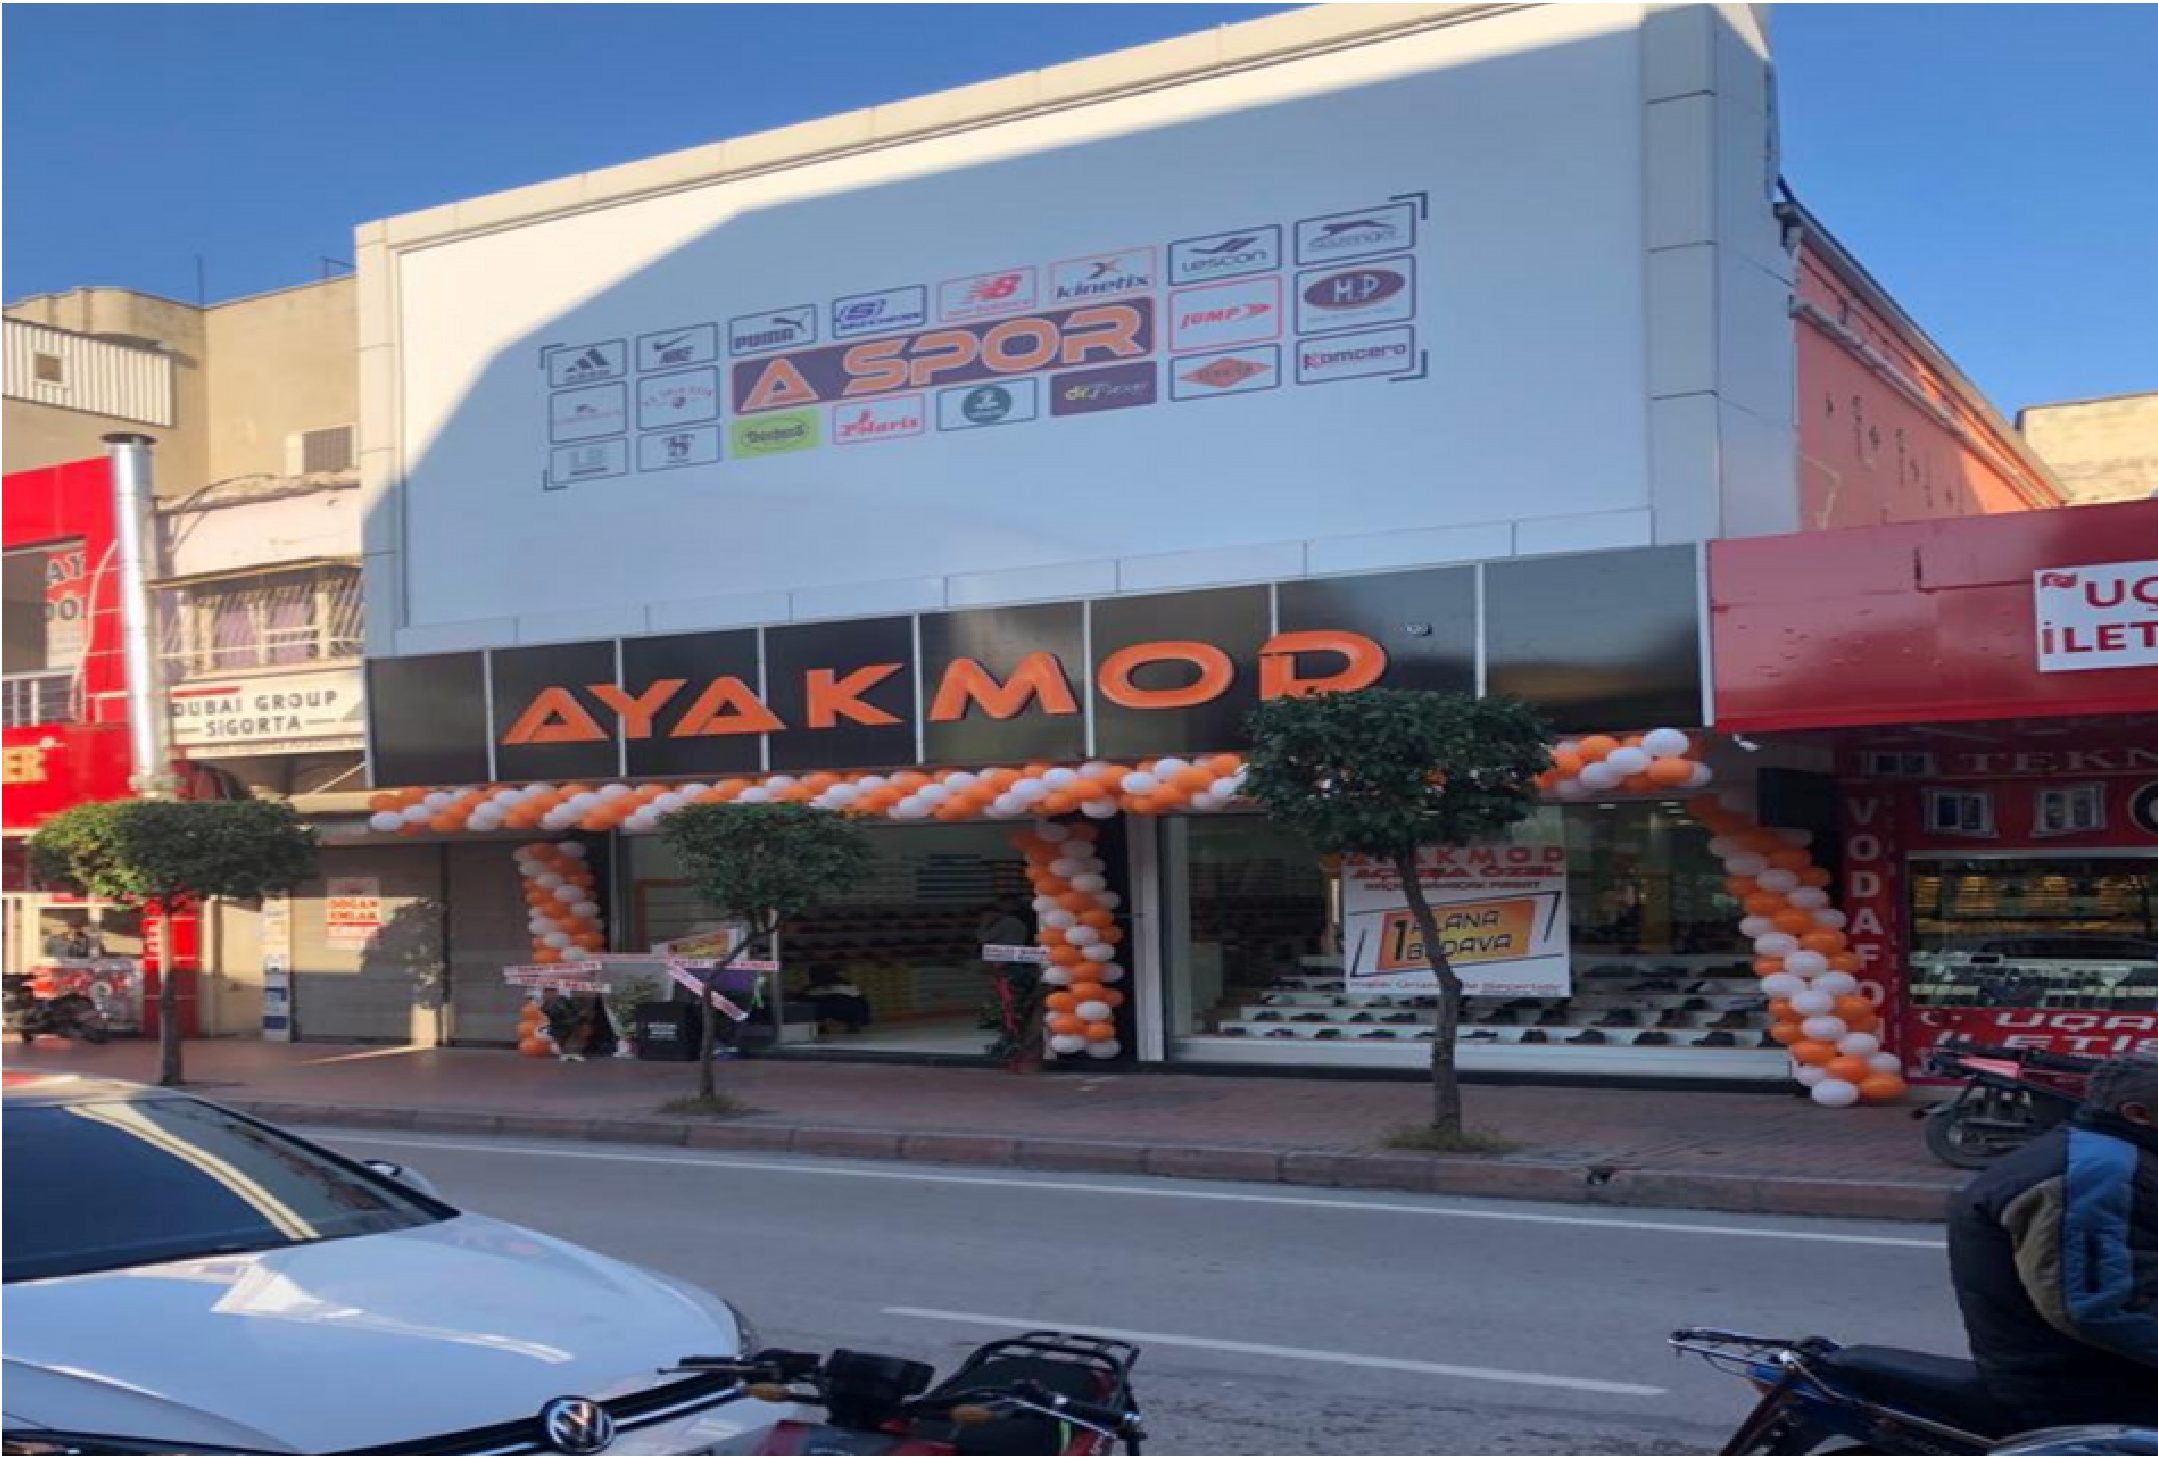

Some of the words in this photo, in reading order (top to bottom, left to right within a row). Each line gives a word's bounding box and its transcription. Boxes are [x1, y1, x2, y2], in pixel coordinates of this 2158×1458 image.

[741, 358, 820, 412] A
[842, 305, 1147, 396] SPOR
[255, 690, 339, 712] GROUP
[498, 630, 1388, 745] AYAKMOD
[1849, 796, 1886, 1044] VODAFO
